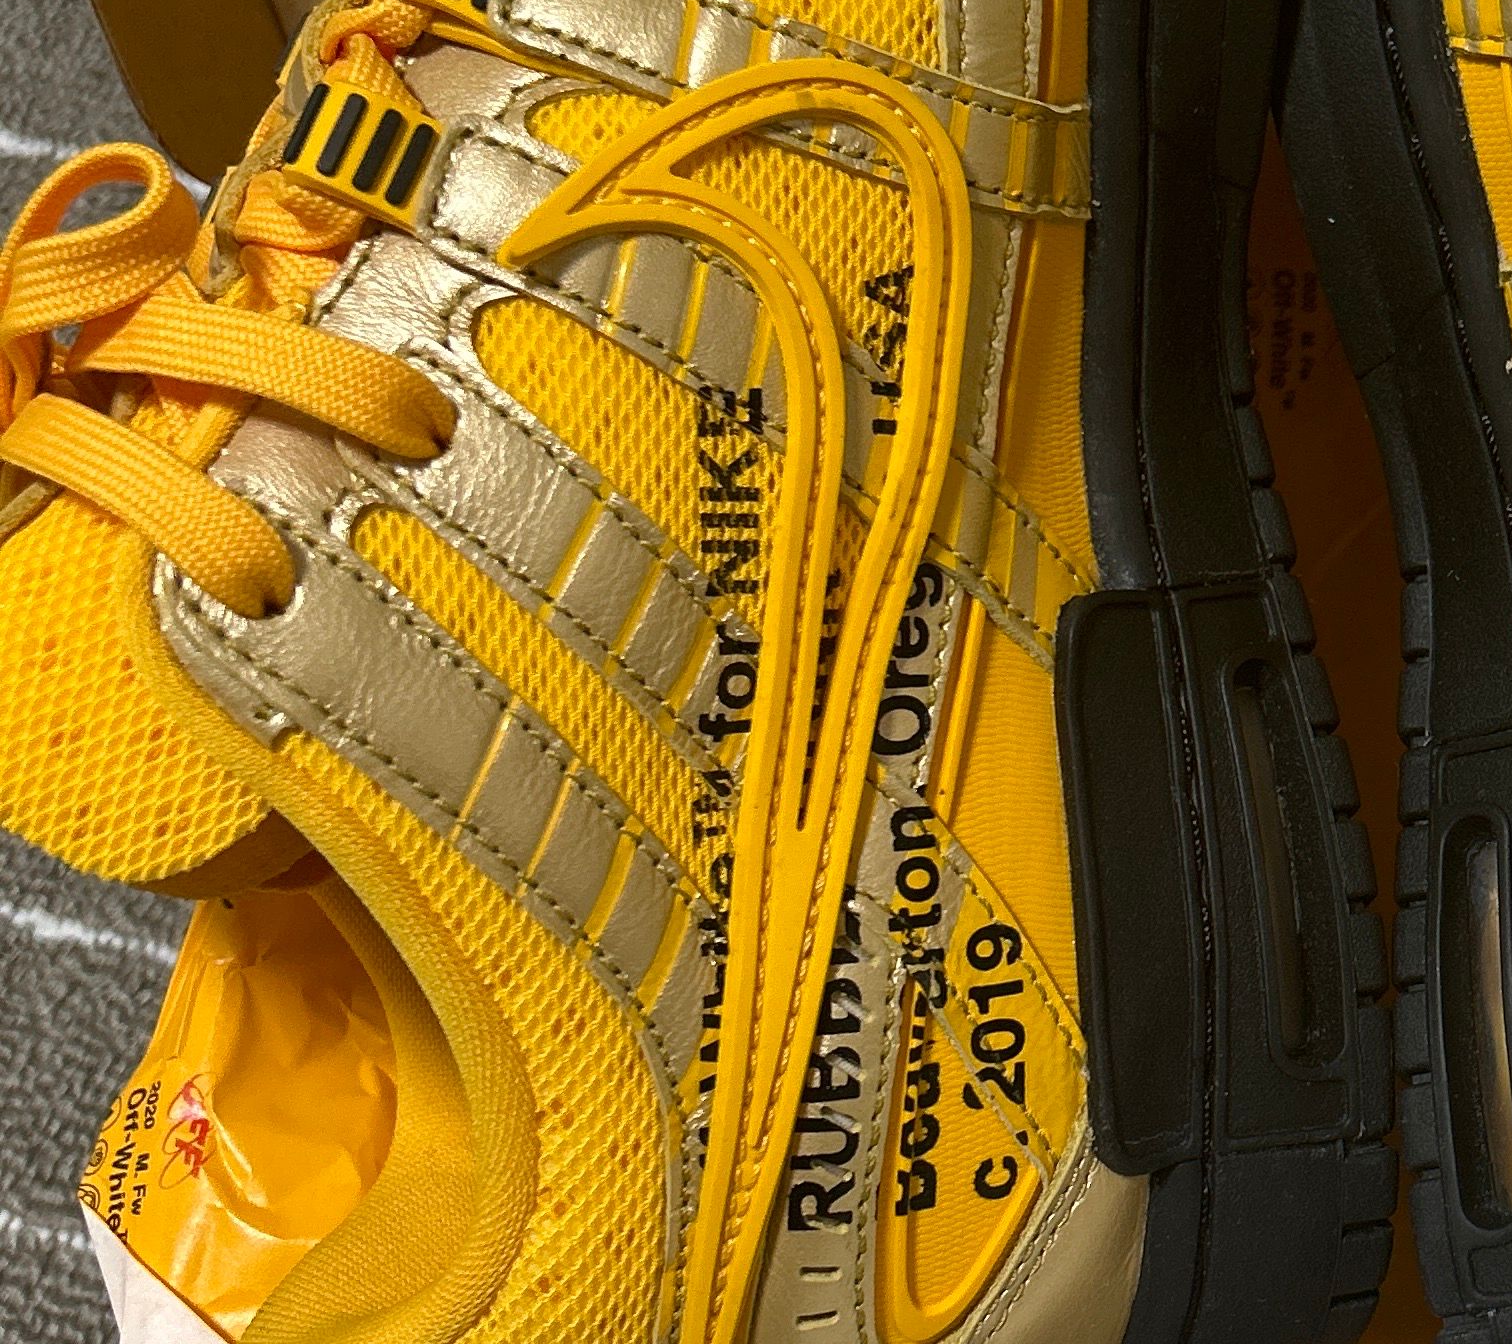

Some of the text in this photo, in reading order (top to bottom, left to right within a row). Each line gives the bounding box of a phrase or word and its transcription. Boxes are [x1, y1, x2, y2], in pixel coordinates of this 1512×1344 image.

[697, 387, 768, 598] NIKE
[699, 620, 763, 743] for
[871, 562, 943, 756] Oreg
[143, 1080, 162, 1130] 2020
[962, 922, 1027, 1111] 2019
